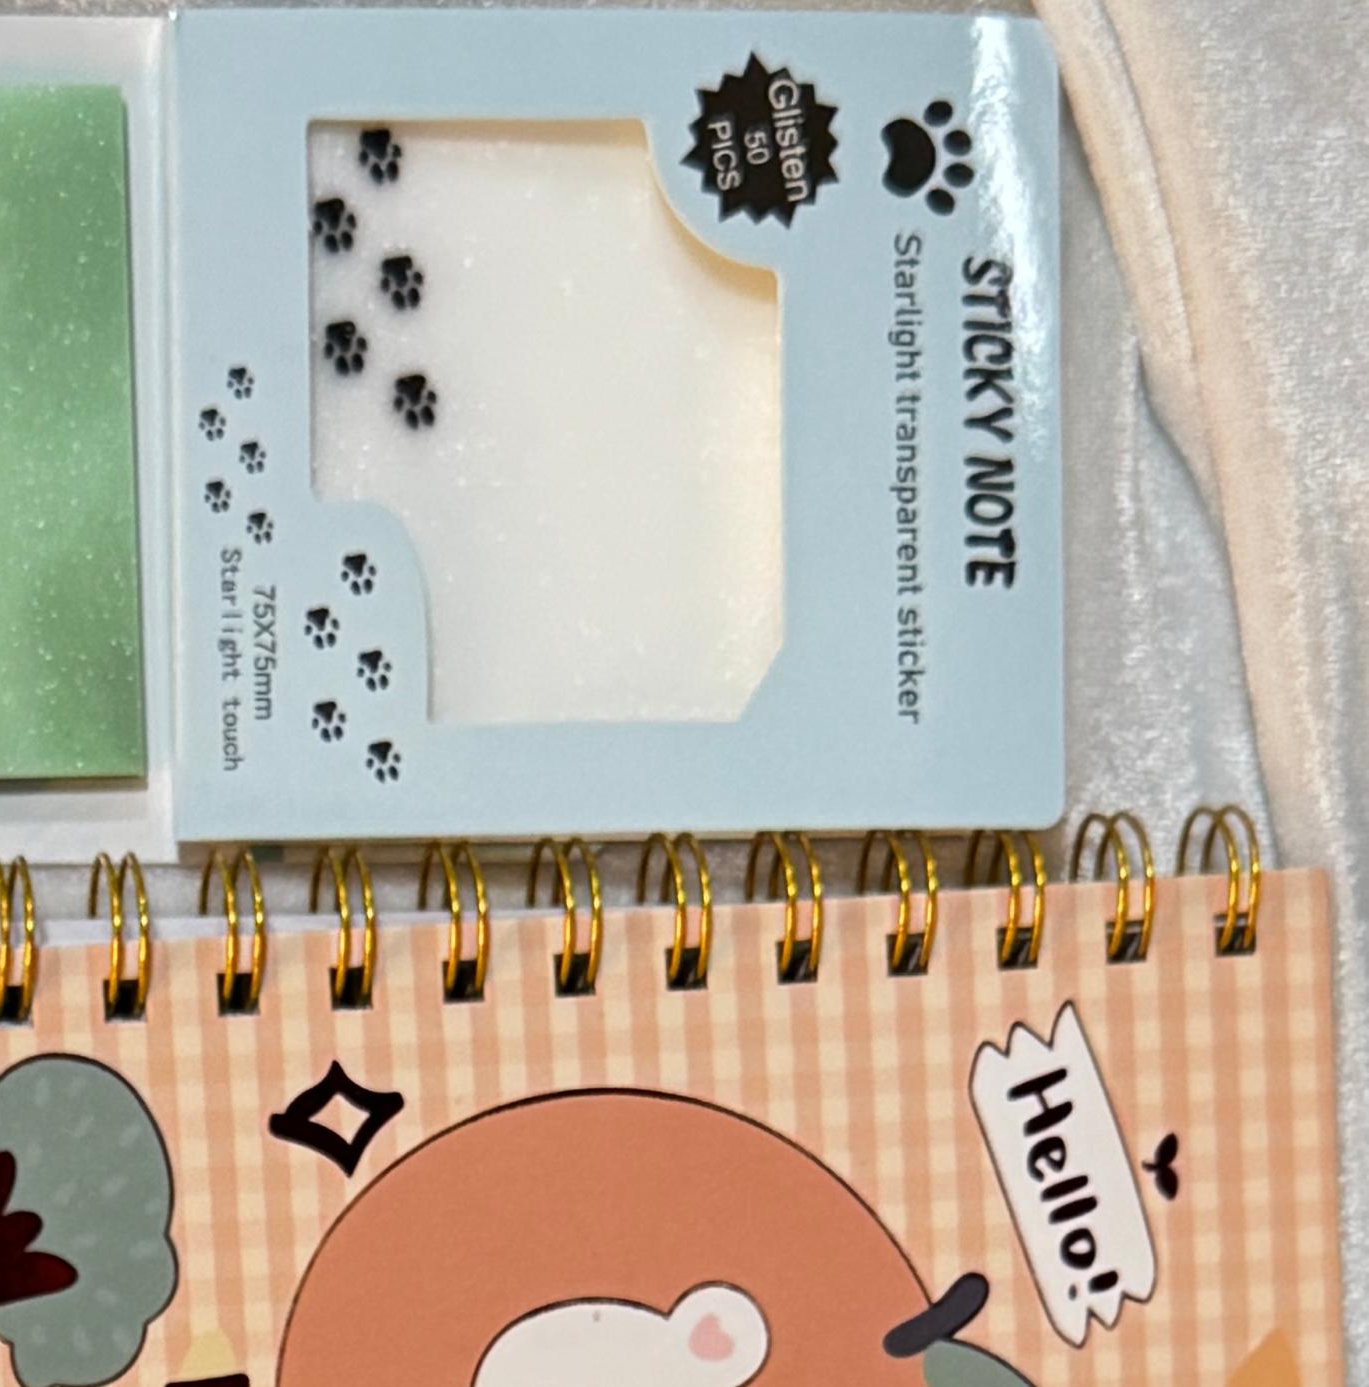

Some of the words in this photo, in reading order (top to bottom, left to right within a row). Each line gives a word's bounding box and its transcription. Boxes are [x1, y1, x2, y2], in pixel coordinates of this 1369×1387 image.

[707, 120, 742, 191] PICS
[744, 131, 770, 165] 50
[768, 79, 808, 201] Glisten
[888, 234, 921, 382] Starlight
[962, 256, 1013, 443] STICKY
[889, 391, 922, 597] transparent
[964, 457, 1016, 588] NOTE
[218, 548, 243, 681] Starlight
[252, 584, 277, 721] 75X75mm
[898, 608, 927, 725] sticker
[222, 696, 244, 772] touch
[1007, 1068, 1120, 1301] Hello!
